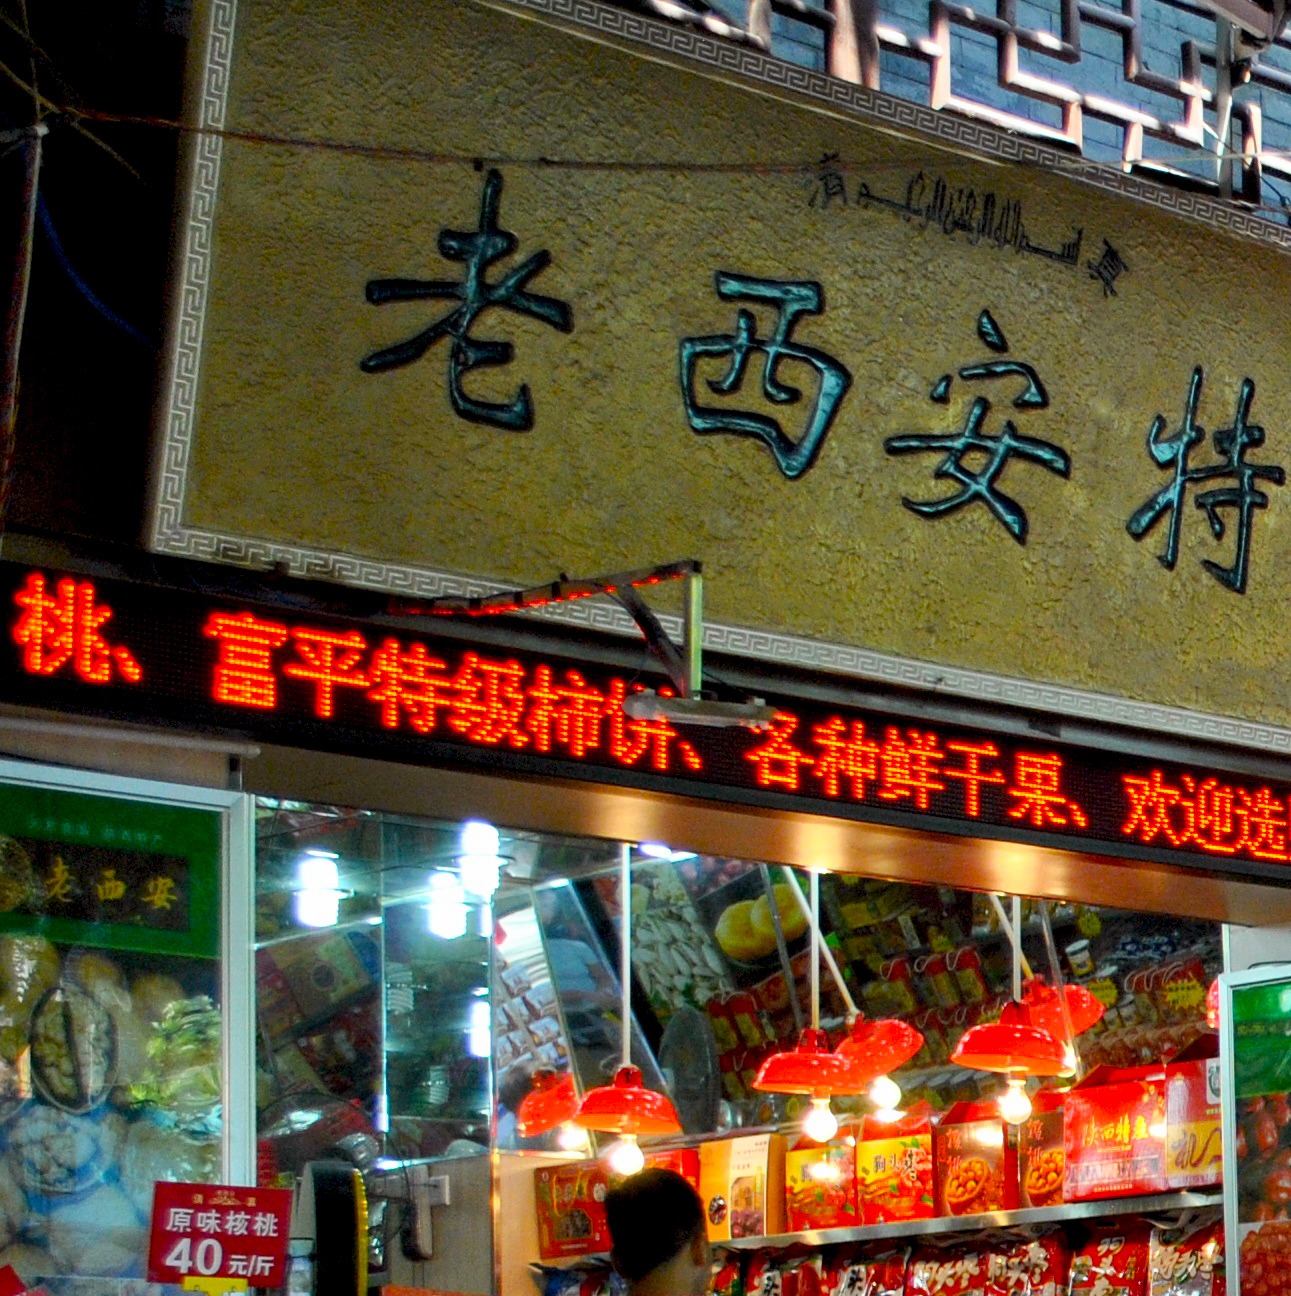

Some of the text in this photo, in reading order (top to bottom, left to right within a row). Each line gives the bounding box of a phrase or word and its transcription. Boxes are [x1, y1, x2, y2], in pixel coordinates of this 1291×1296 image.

[45, 855, 178, 912] 老西安
[165, 1207, 279, 1238] 原味核桃
[165, 1237, 275, 1277] 40 元/斤
